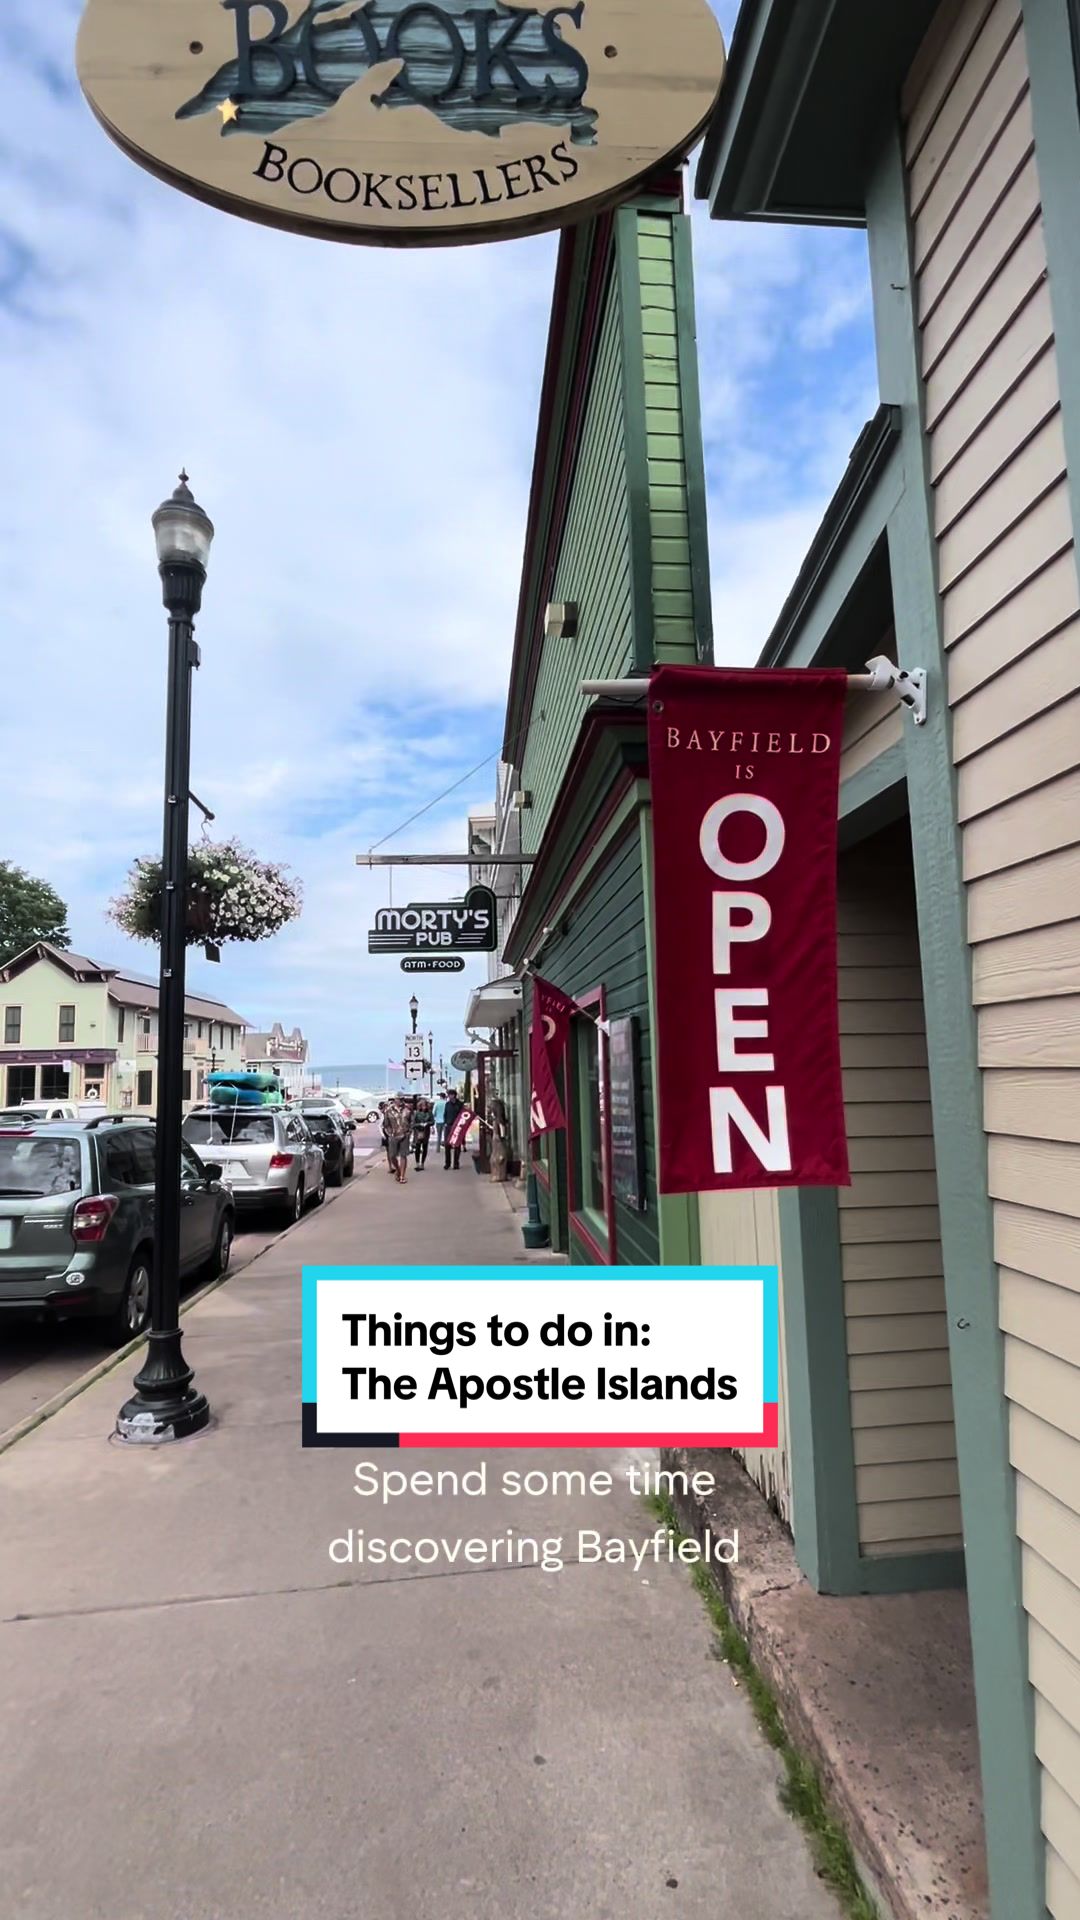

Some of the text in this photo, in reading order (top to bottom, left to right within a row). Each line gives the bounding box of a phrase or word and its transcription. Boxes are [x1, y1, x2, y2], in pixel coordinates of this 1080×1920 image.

[253, 140, 579, 211] BOOKSELLERS
[666, 726, 832, 755] BAYFIELD
[735, 764, 755, 780] IS
[377, 909, 490, 931] MORTY'S
[416, 932, 453, 946] PUB
[699, 793, 792, 1174] OPEN
[408, 1046, 420, 1057] 13
